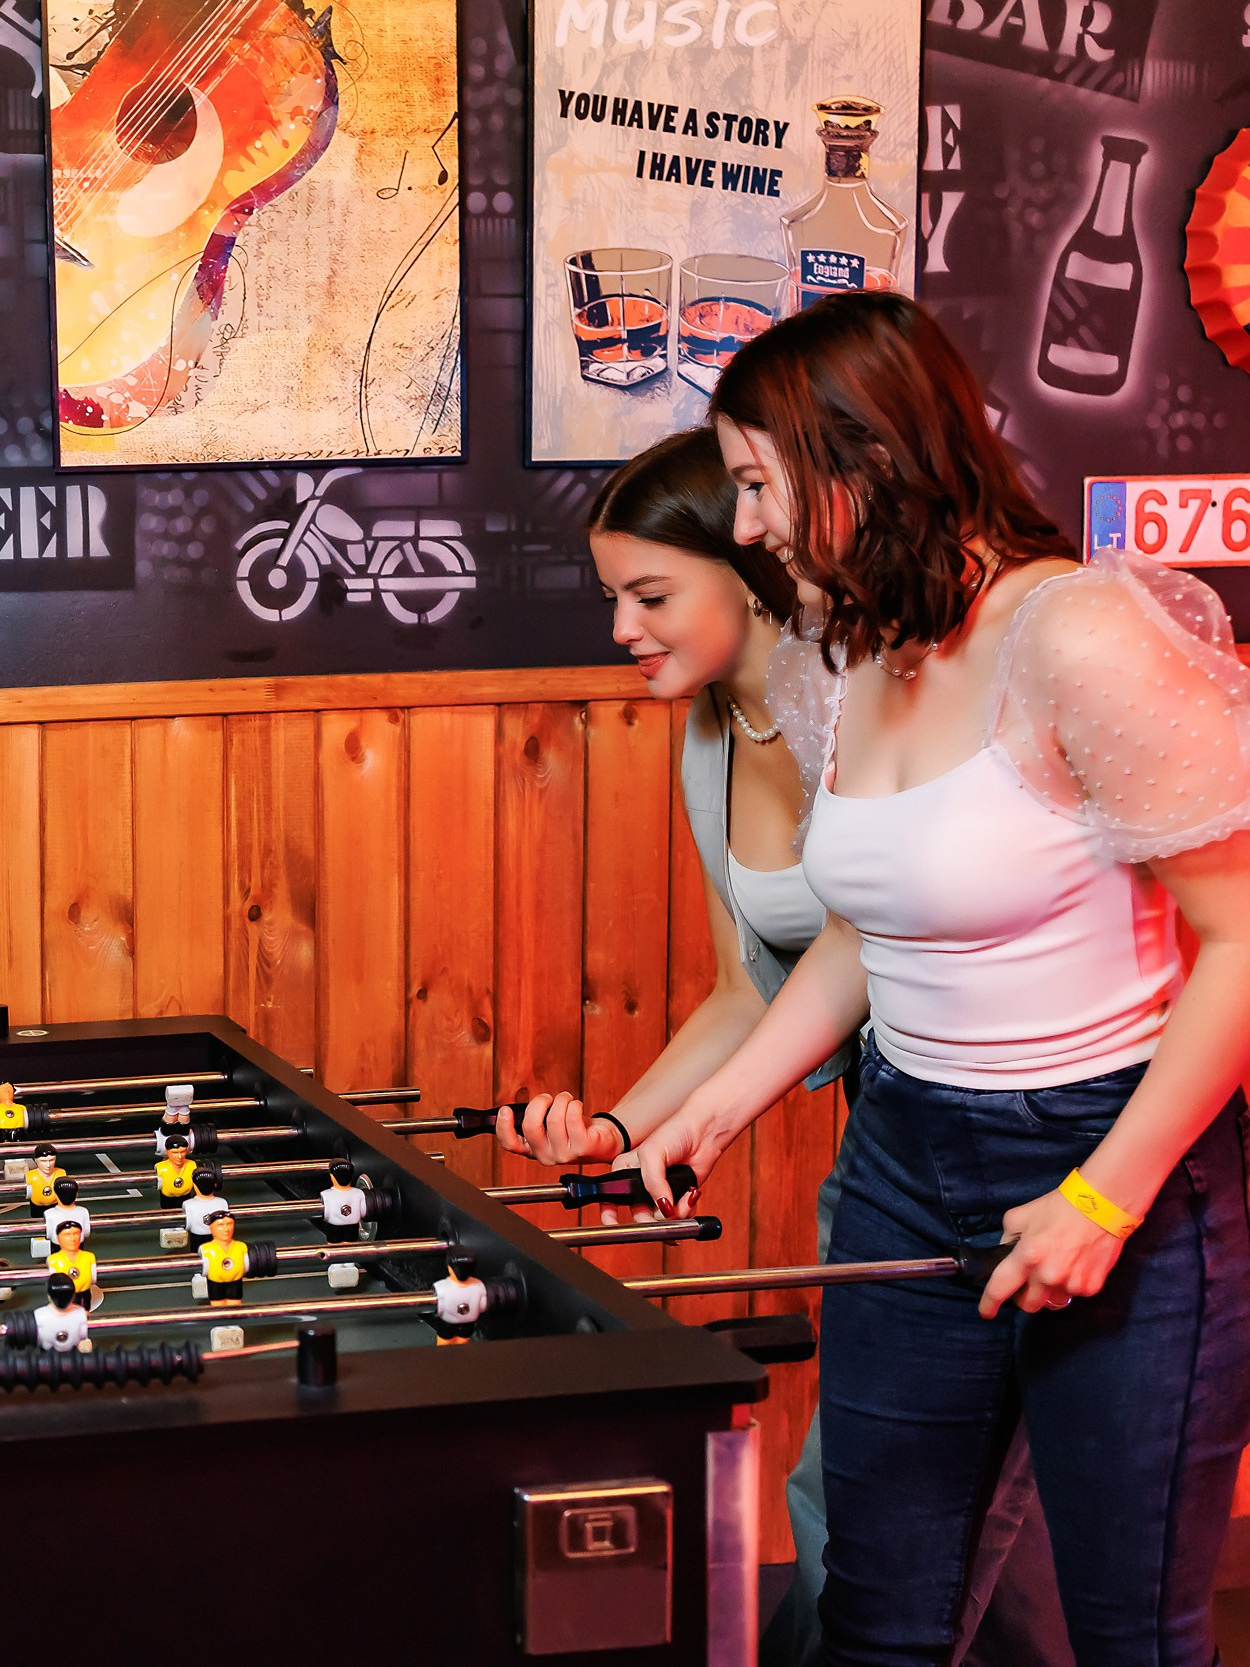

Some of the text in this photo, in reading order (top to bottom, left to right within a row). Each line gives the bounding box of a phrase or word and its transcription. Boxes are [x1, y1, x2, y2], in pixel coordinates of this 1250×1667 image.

[558, 89, 790, 149] YOU HAVE A STORY
[636, 149, 783, 197] I HAVE WINE
[1094, 532, 1122, 550] LT
